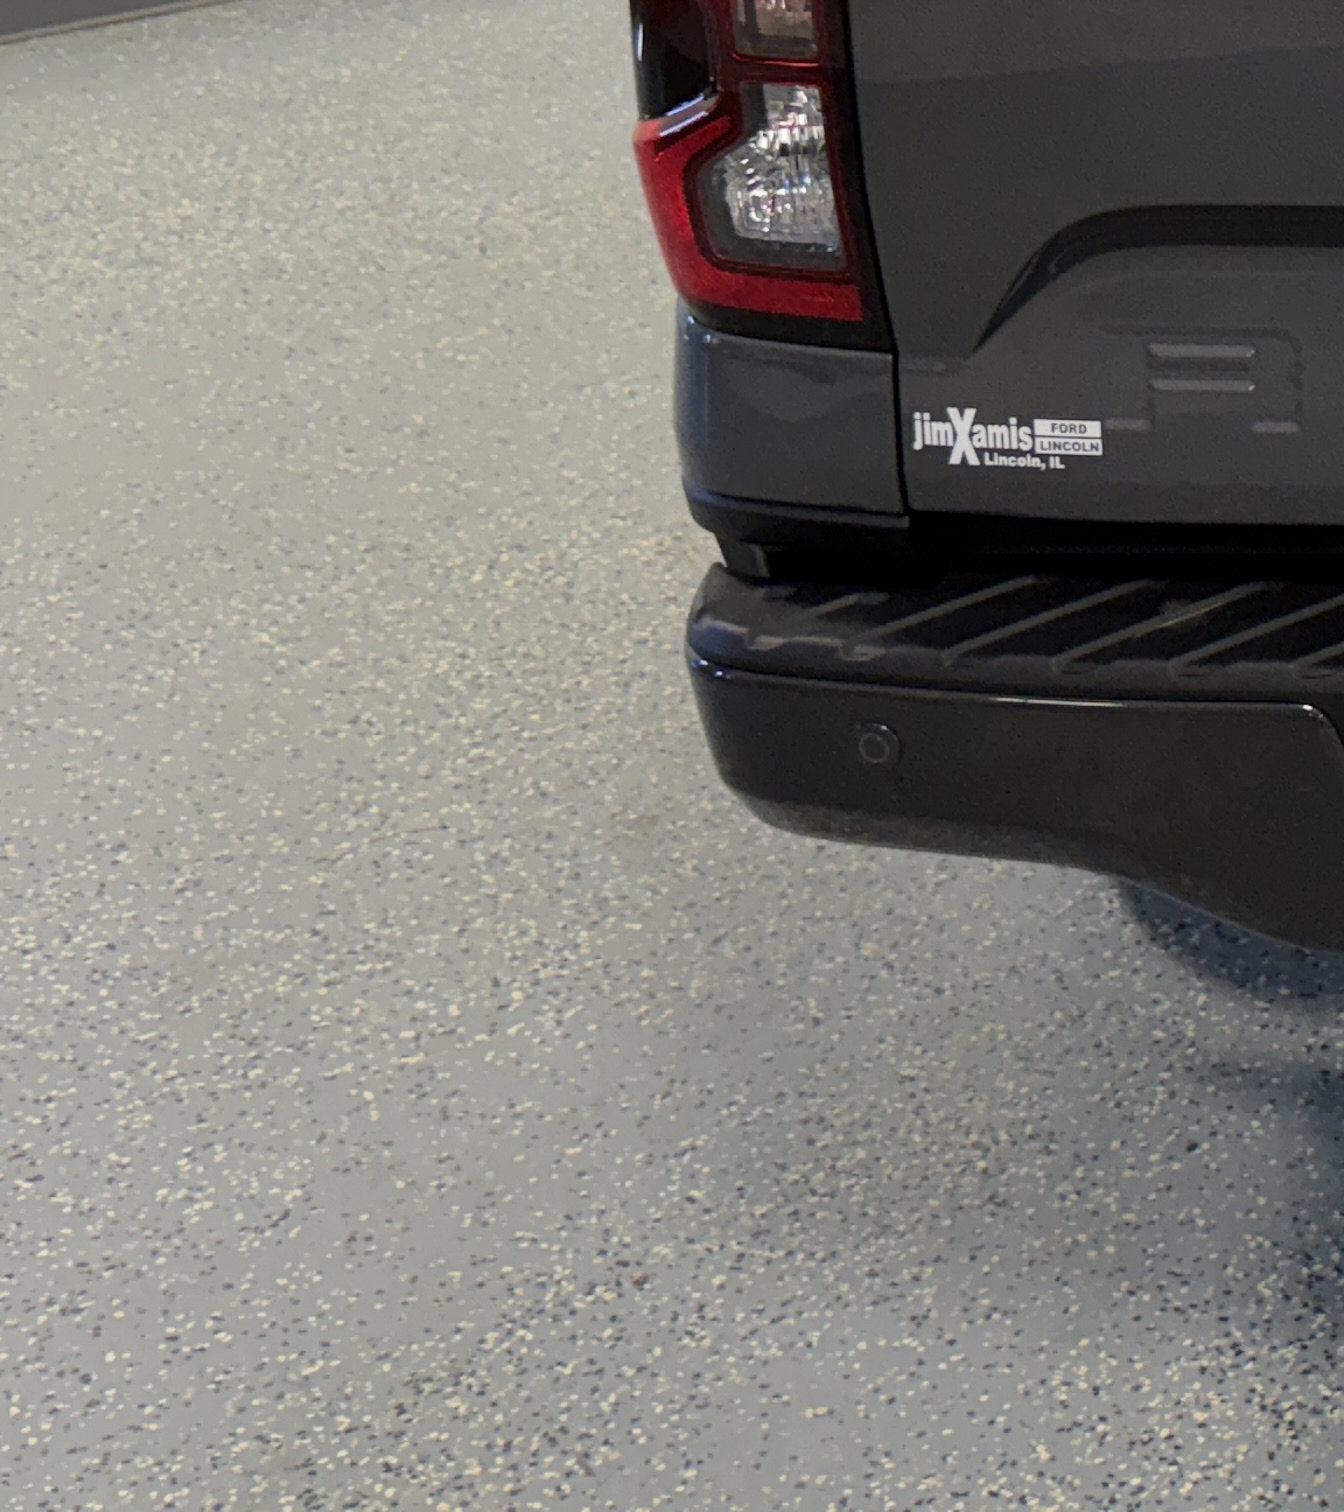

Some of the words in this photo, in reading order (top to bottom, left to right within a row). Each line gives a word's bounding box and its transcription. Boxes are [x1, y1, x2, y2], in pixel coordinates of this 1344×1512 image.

[1050, 422, 1088, 435] FORD
[1039, 440, 1100, 453] LINCOLN
[983, 452, 1046, 471] Lincoln,
[1049, 455, 1066, 470] IL
